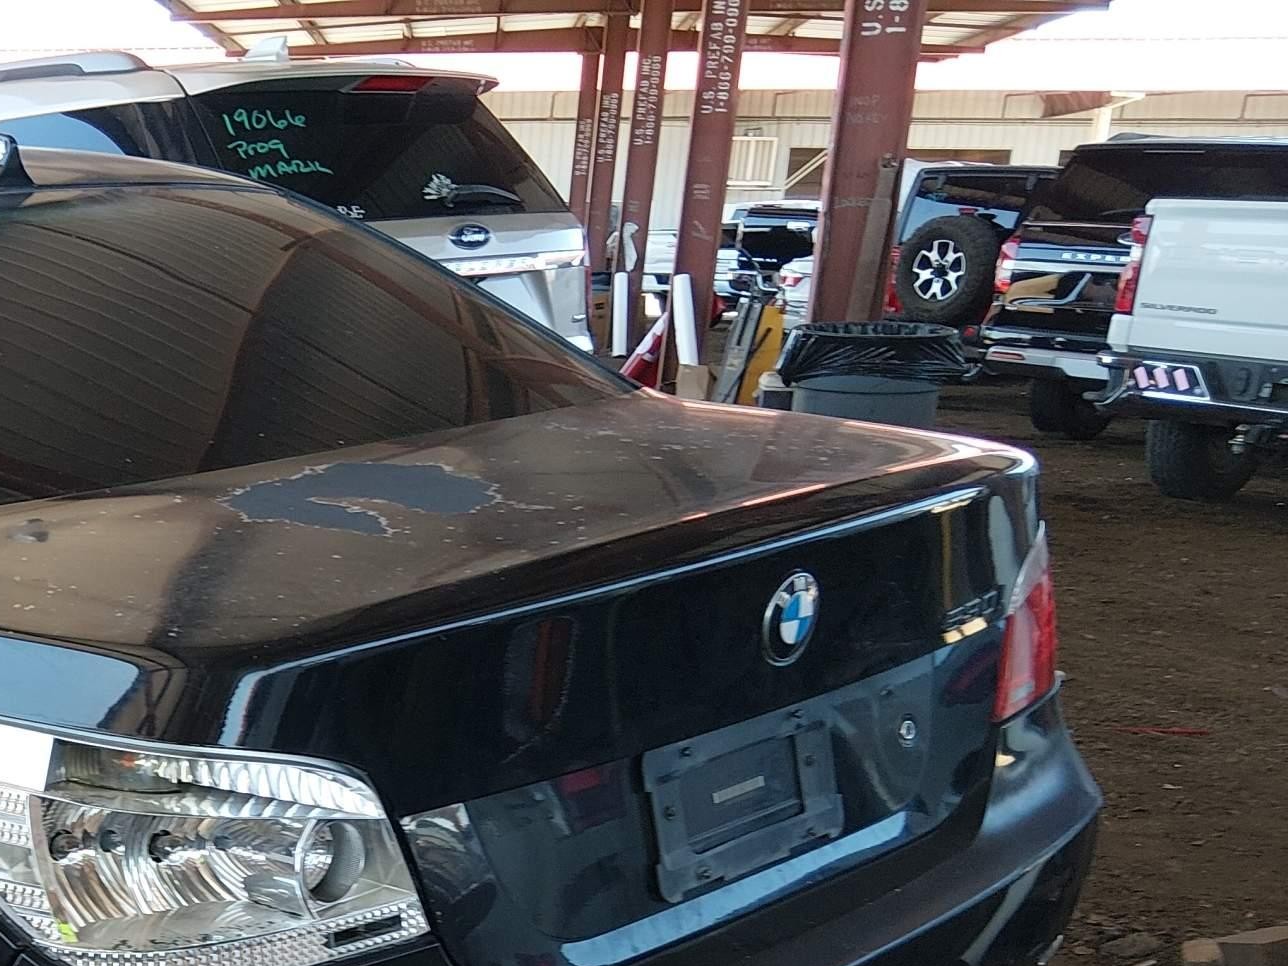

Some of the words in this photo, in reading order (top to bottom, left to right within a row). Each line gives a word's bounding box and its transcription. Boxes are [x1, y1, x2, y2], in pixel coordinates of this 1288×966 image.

[704, 22, 724, 79] PREFAB
[222, 108, 307, 136] 19066
[1140, 302, 1218, 315] SILVERADO
